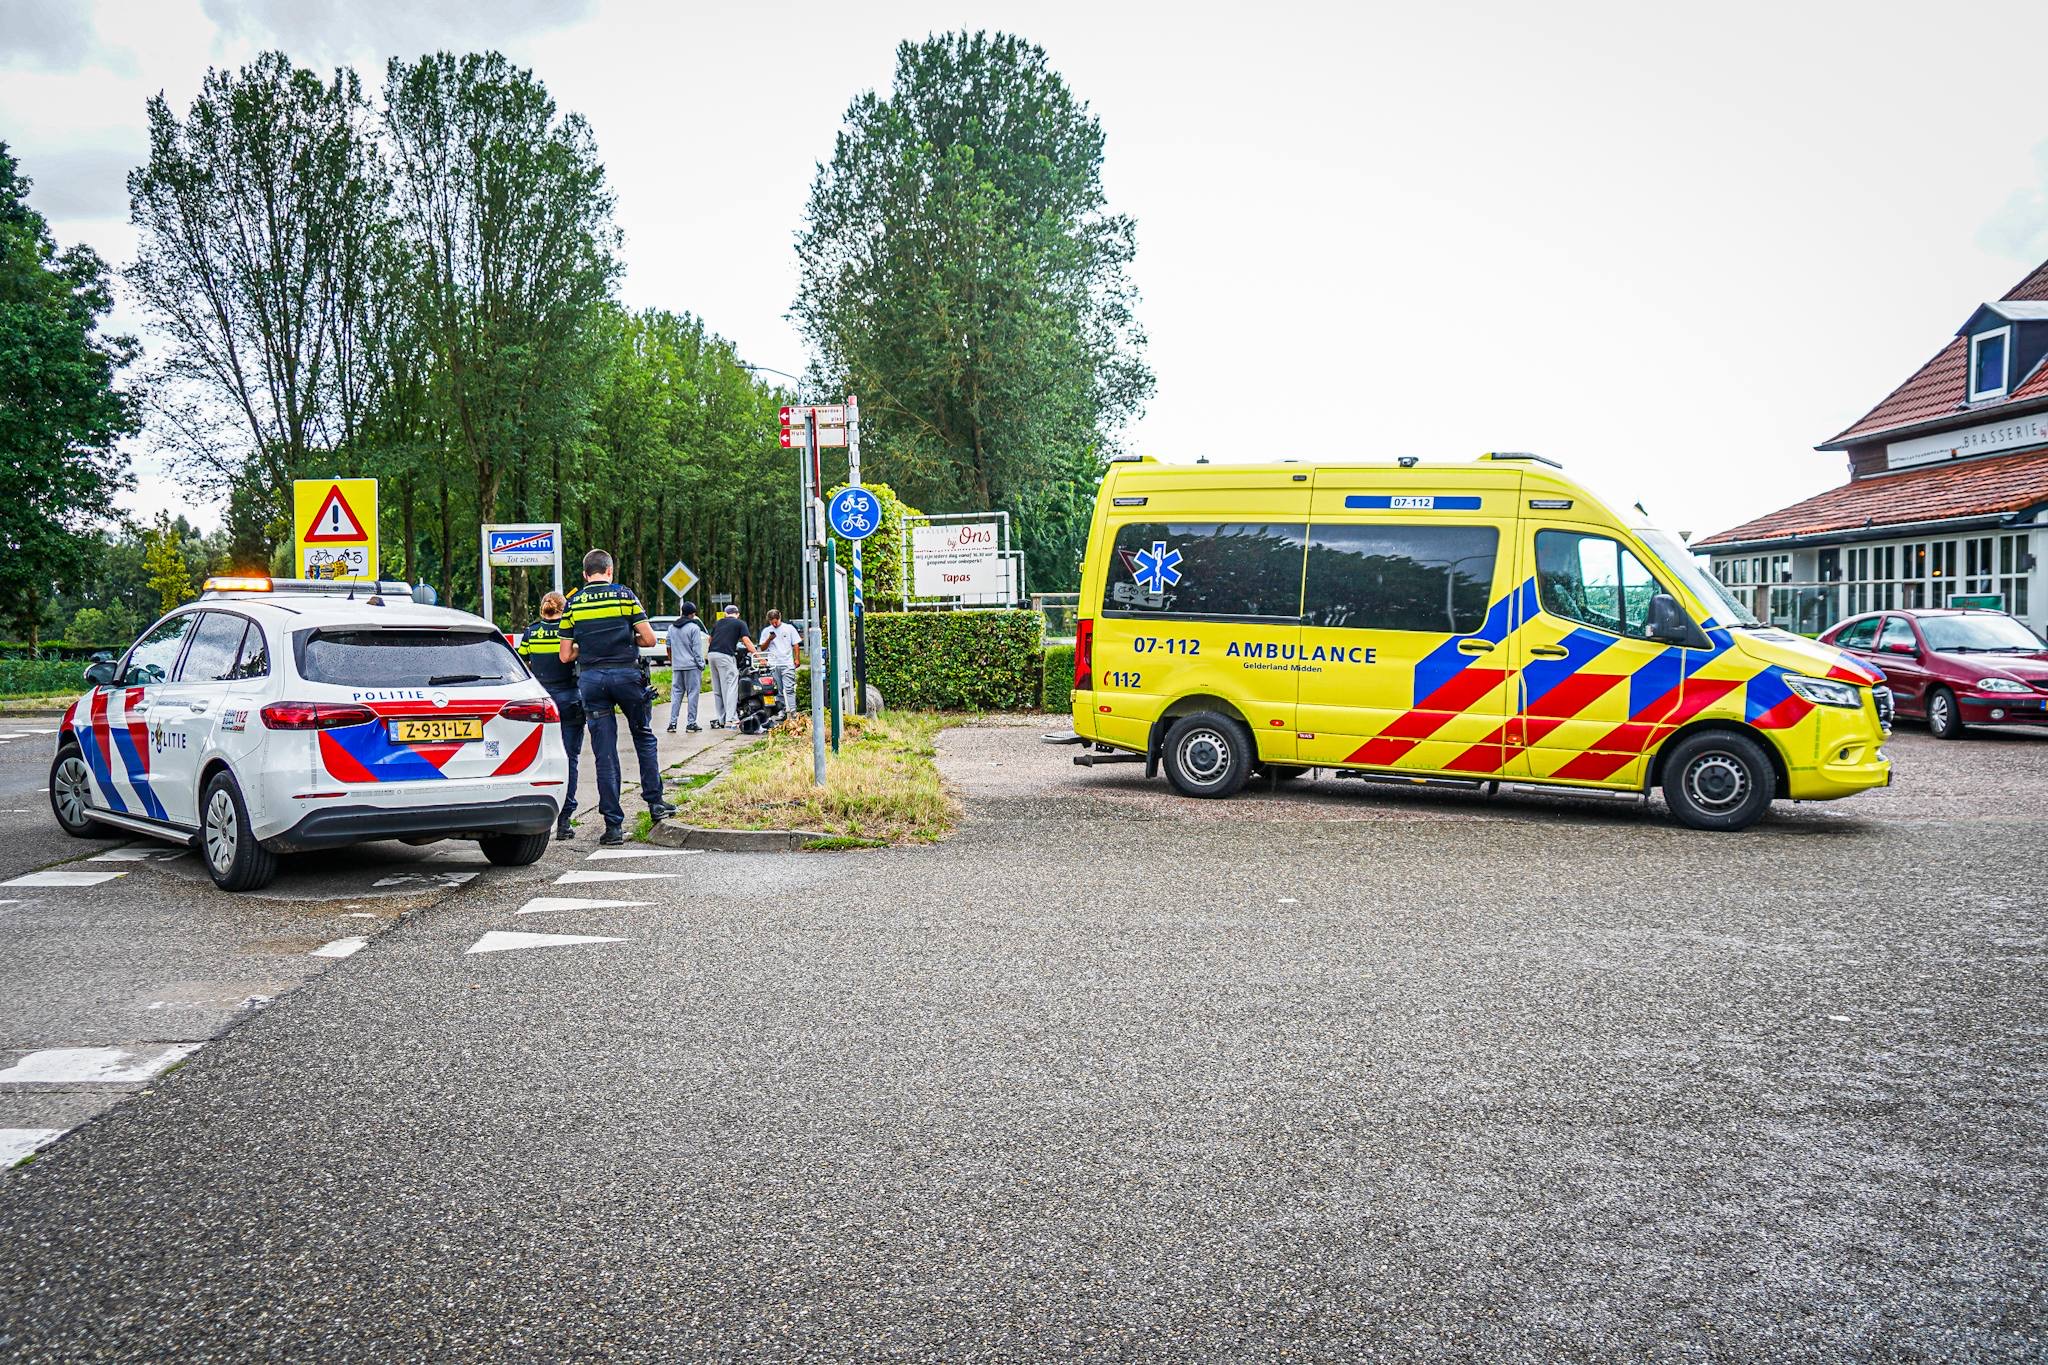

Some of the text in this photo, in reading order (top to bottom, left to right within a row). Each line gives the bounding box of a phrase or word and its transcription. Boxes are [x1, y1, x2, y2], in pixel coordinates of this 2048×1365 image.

[1964, 422, 2037, 449] BRASSERIE
[1394, 498, 1430, 507] 07-112
[947, 526, 991, 548] by Ons
[942, 573, 971, 584] Tapas
[1134, 637, 1377, 664] 07-112 AMBULANCE
[1243, 662, 1322, 673] Gelderland Midden
[353, 690, 425, 701] POLITIE
[406, 722, 472, 738] Z-931-LZ
[150, 730, 187, 753] POLITIE
